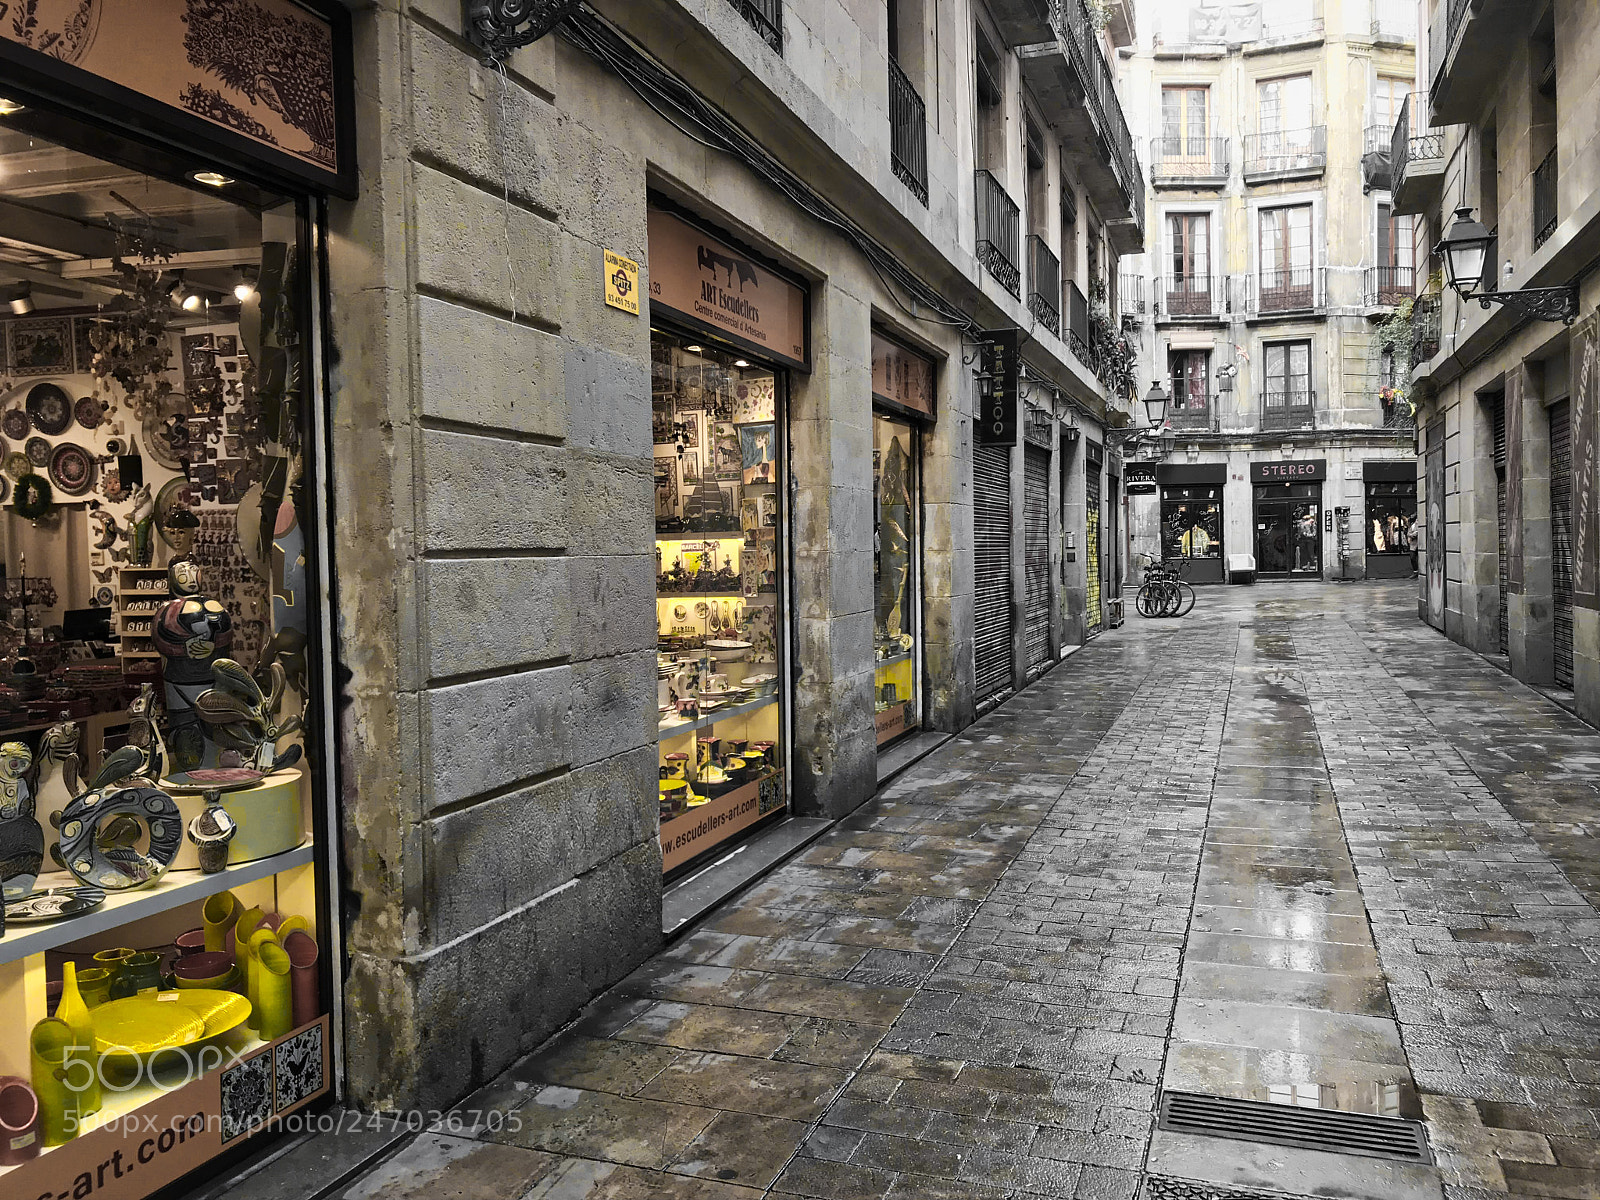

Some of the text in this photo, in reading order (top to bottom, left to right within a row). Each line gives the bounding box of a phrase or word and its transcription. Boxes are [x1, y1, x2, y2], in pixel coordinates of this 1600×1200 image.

[613, 276, 630, 290] SPITZ
[694, 300, 713, 318] Centre
[714, 312, 739, 329] comercial
[701, 280, 759, 323] ART Escudellers
[992, 345, 1004, 436] TATTOO
[1262, 464, 1315, 476] STEREO
